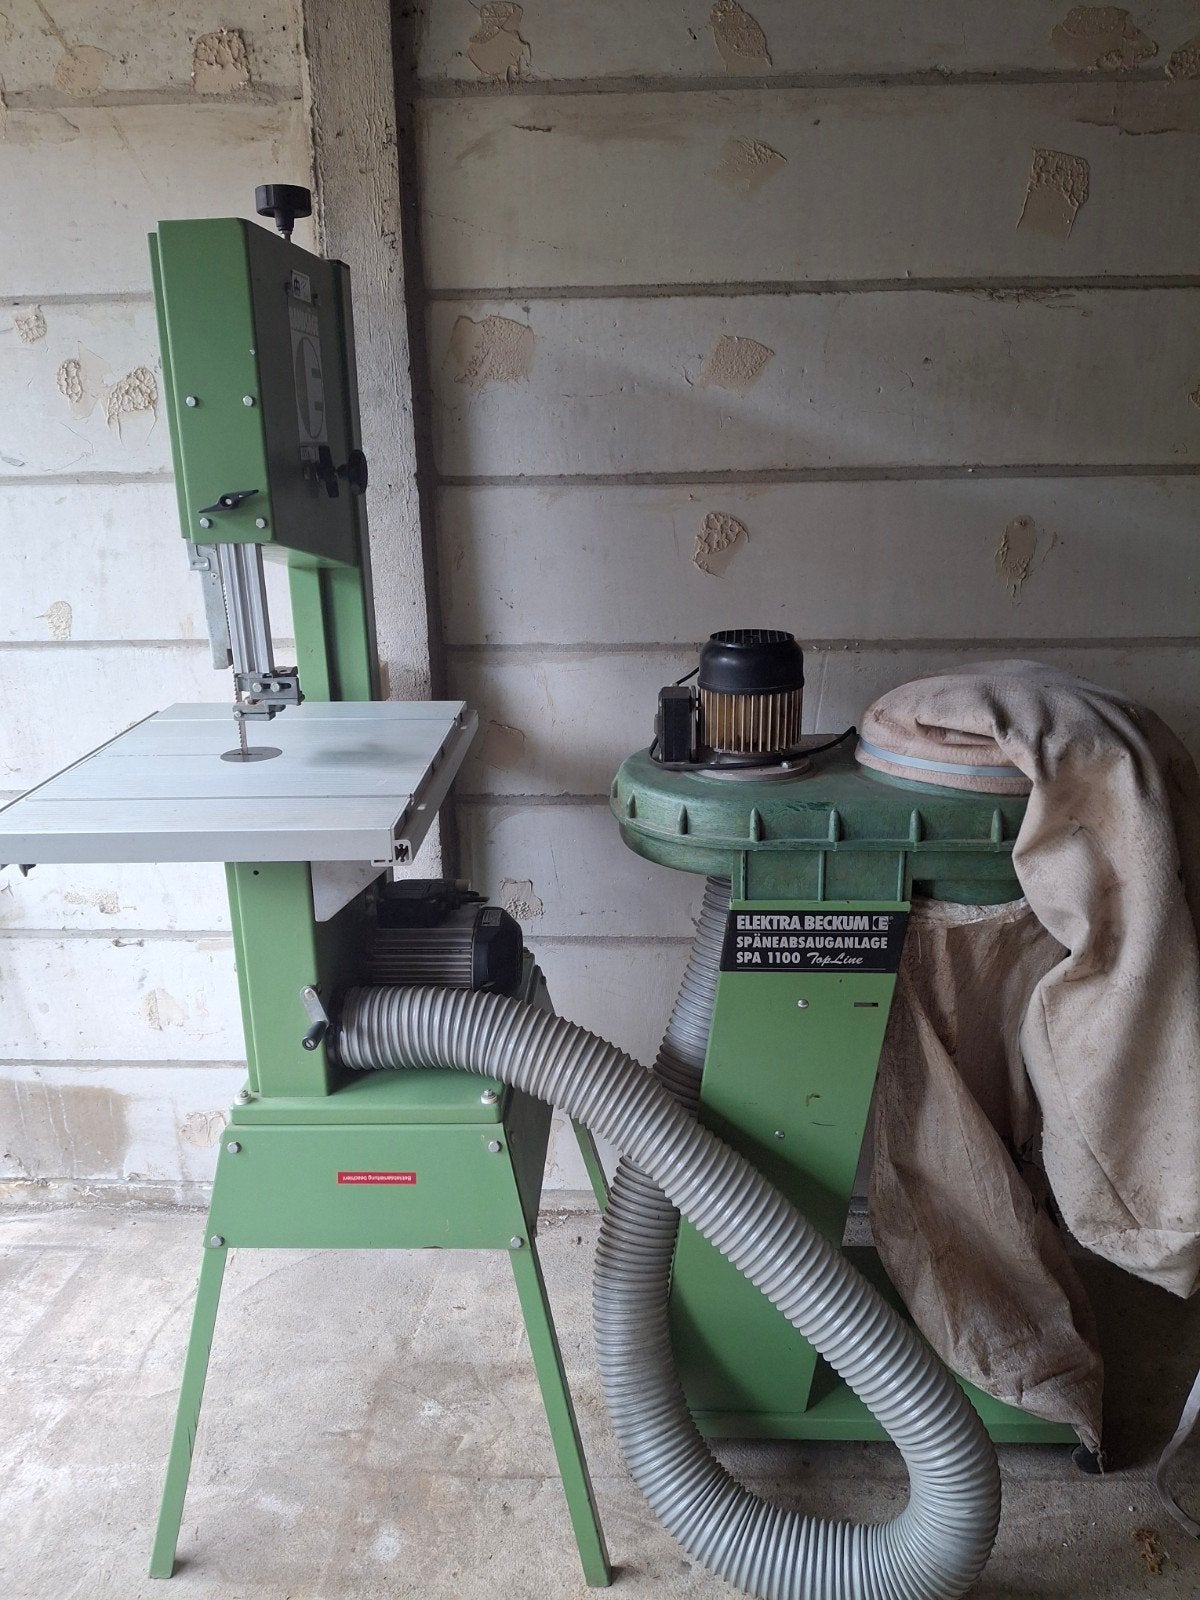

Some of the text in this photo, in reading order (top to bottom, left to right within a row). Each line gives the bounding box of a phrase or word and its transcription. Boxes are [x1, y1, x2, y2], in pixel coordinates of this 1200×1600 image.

[736, 915, 800, 931] ELEKTRA
[804, 915, 869, 931] BECKUM
[736, 933, 888, 949] SPÄNEABSAUGANLAGE
[736, 952, 762, 964] SPA
[767, 952, 801, 964] 1100
